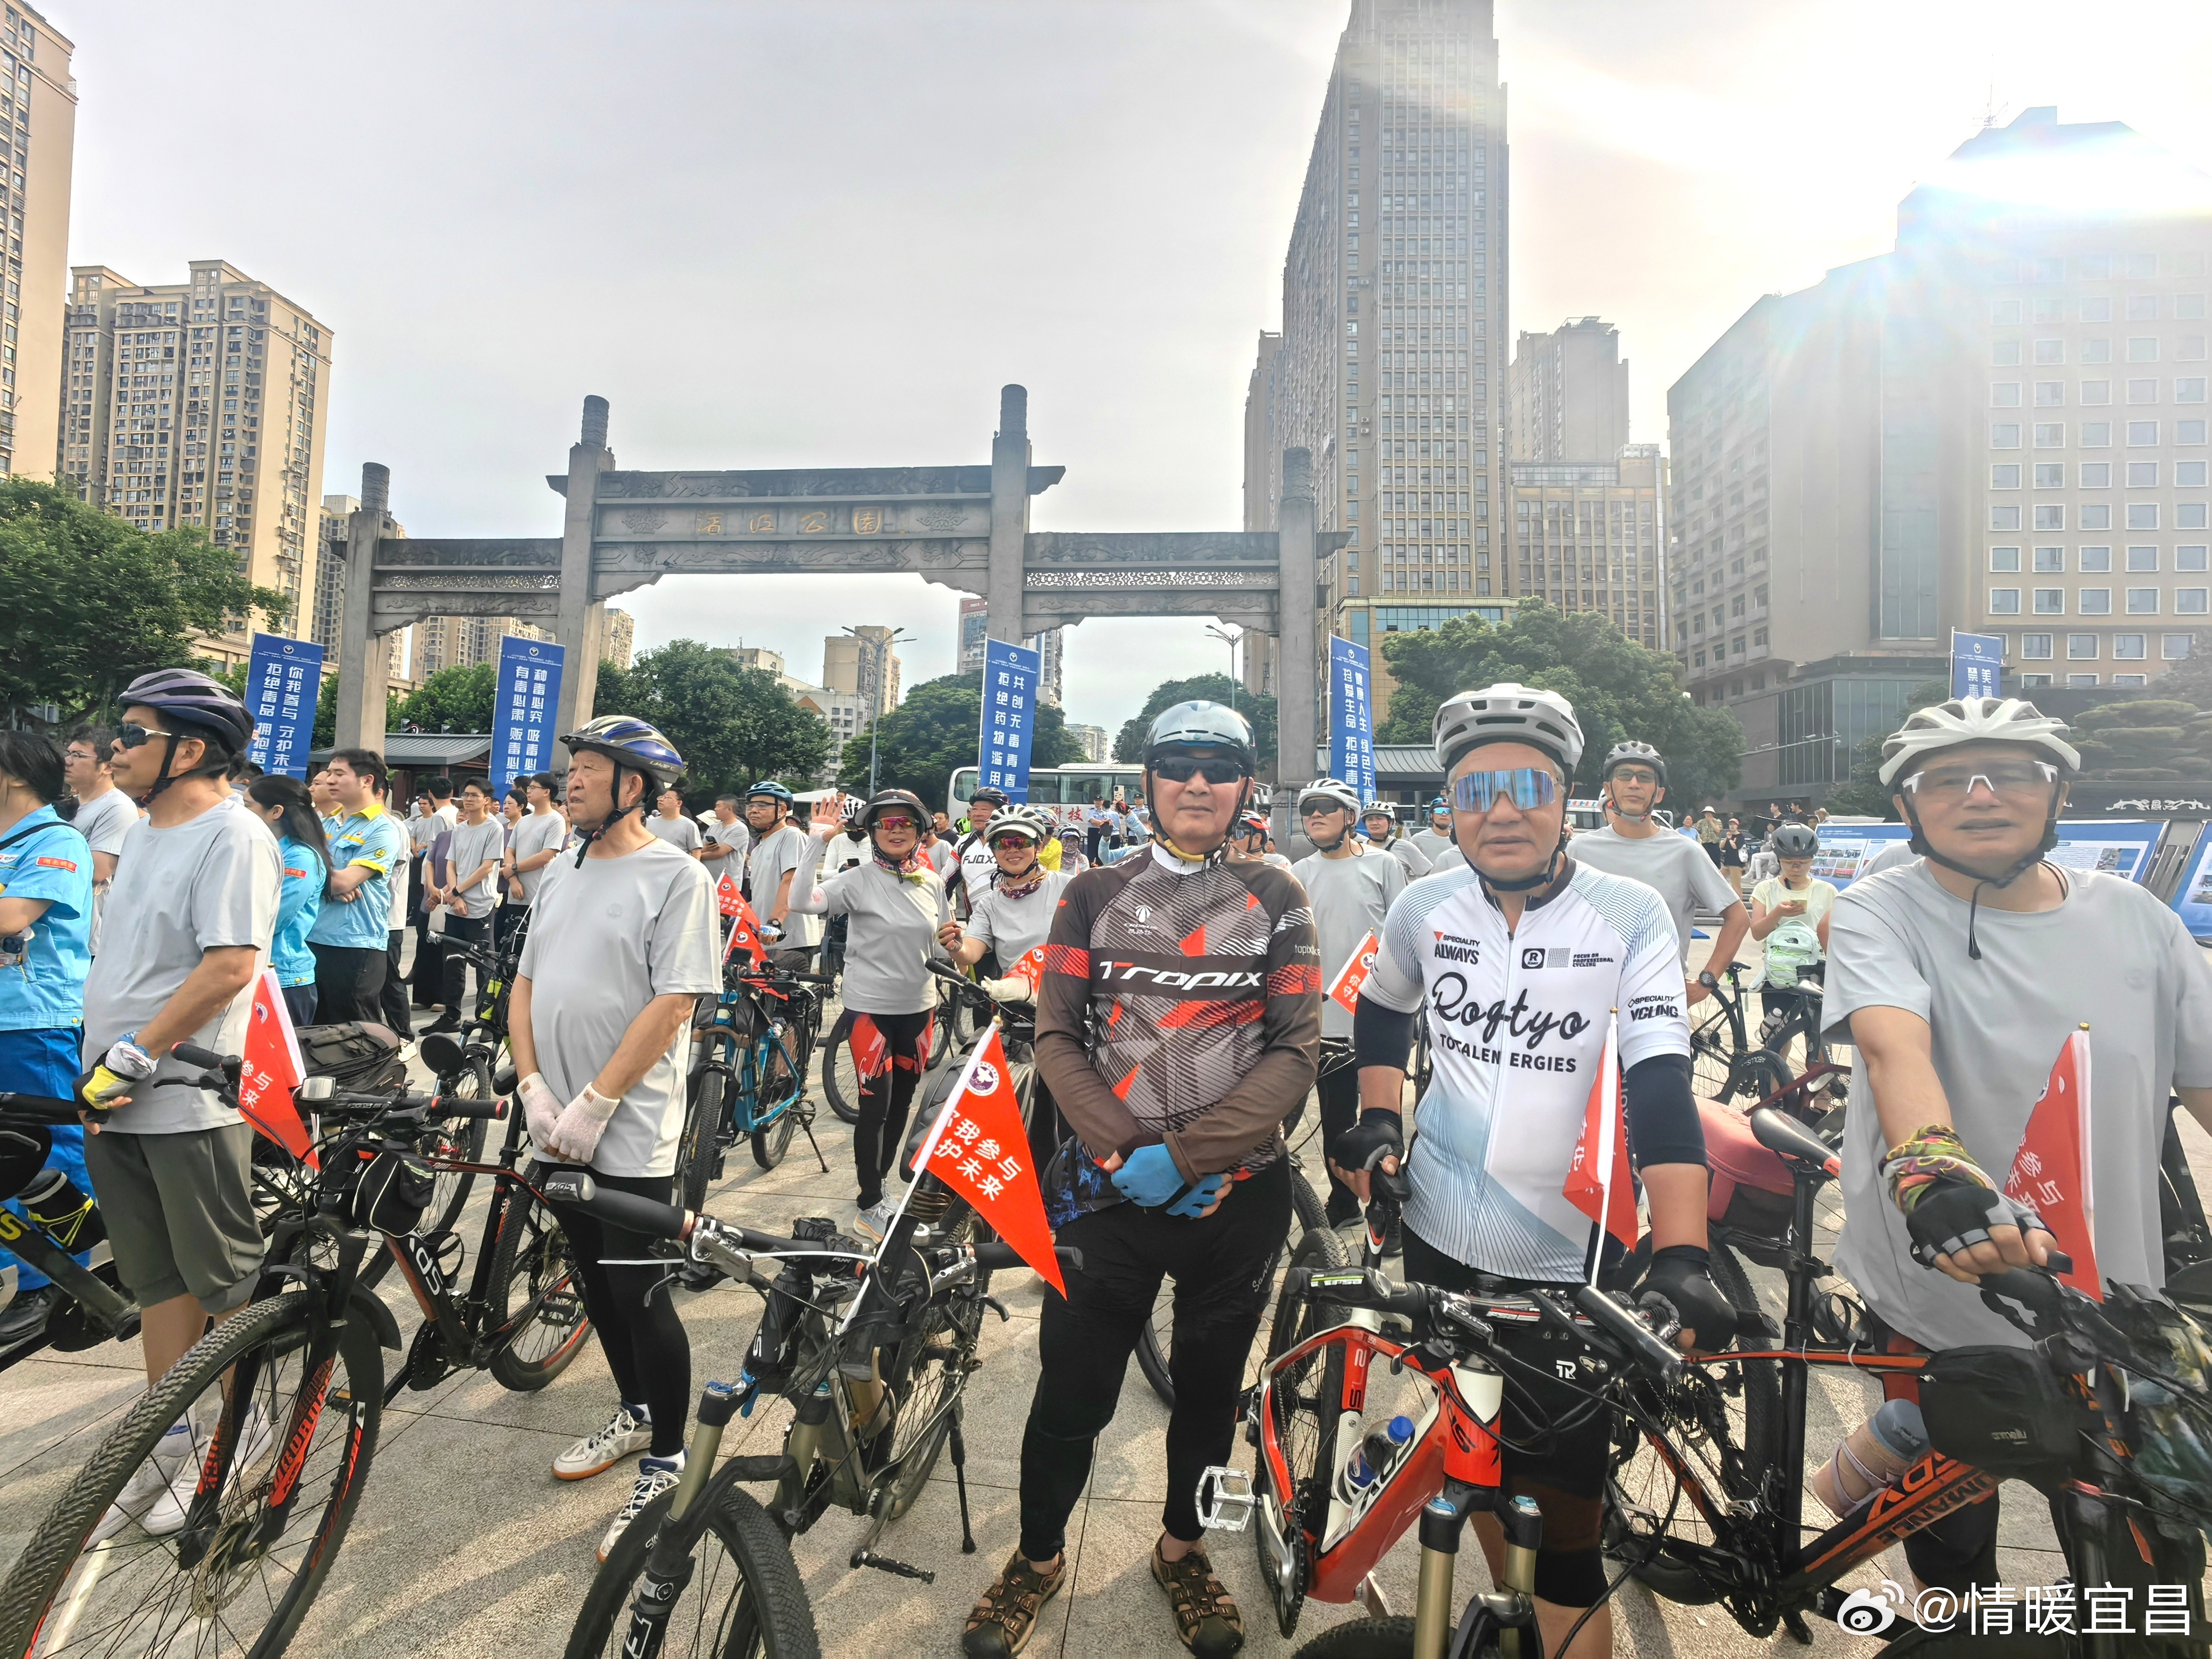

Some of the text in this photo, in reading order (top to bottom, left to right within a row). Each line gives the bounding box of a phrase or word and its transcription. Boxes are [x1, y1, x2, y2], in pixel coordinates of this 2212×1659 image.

[250, 663, 282, 771] 拒绝毒品 拥抱梦
[281, 666, 304, 720] 你我参与
[505, 666, 529, 785] 有毒必肃 贩毒必惩
[523, 668, 547, 778] 种毒必究 吸毒必
[989, 672, 1010, 786] 拒绝药物滥用
[1004, 675, 1024, 788] 共创无毒青春
[1343, 668, 1359, 793] 珍爱生命 拒绝毒
[1355, 672, 1373, 803] 健康人生 绿色无毒
[963, 854, 998, 865] FJQX
[1434, 943, 1480, 965] ALWAYS
[1443, 934, 1481, 947] SPECIALITY
[1635, 995, 1675, 1004] SPECIALITY
